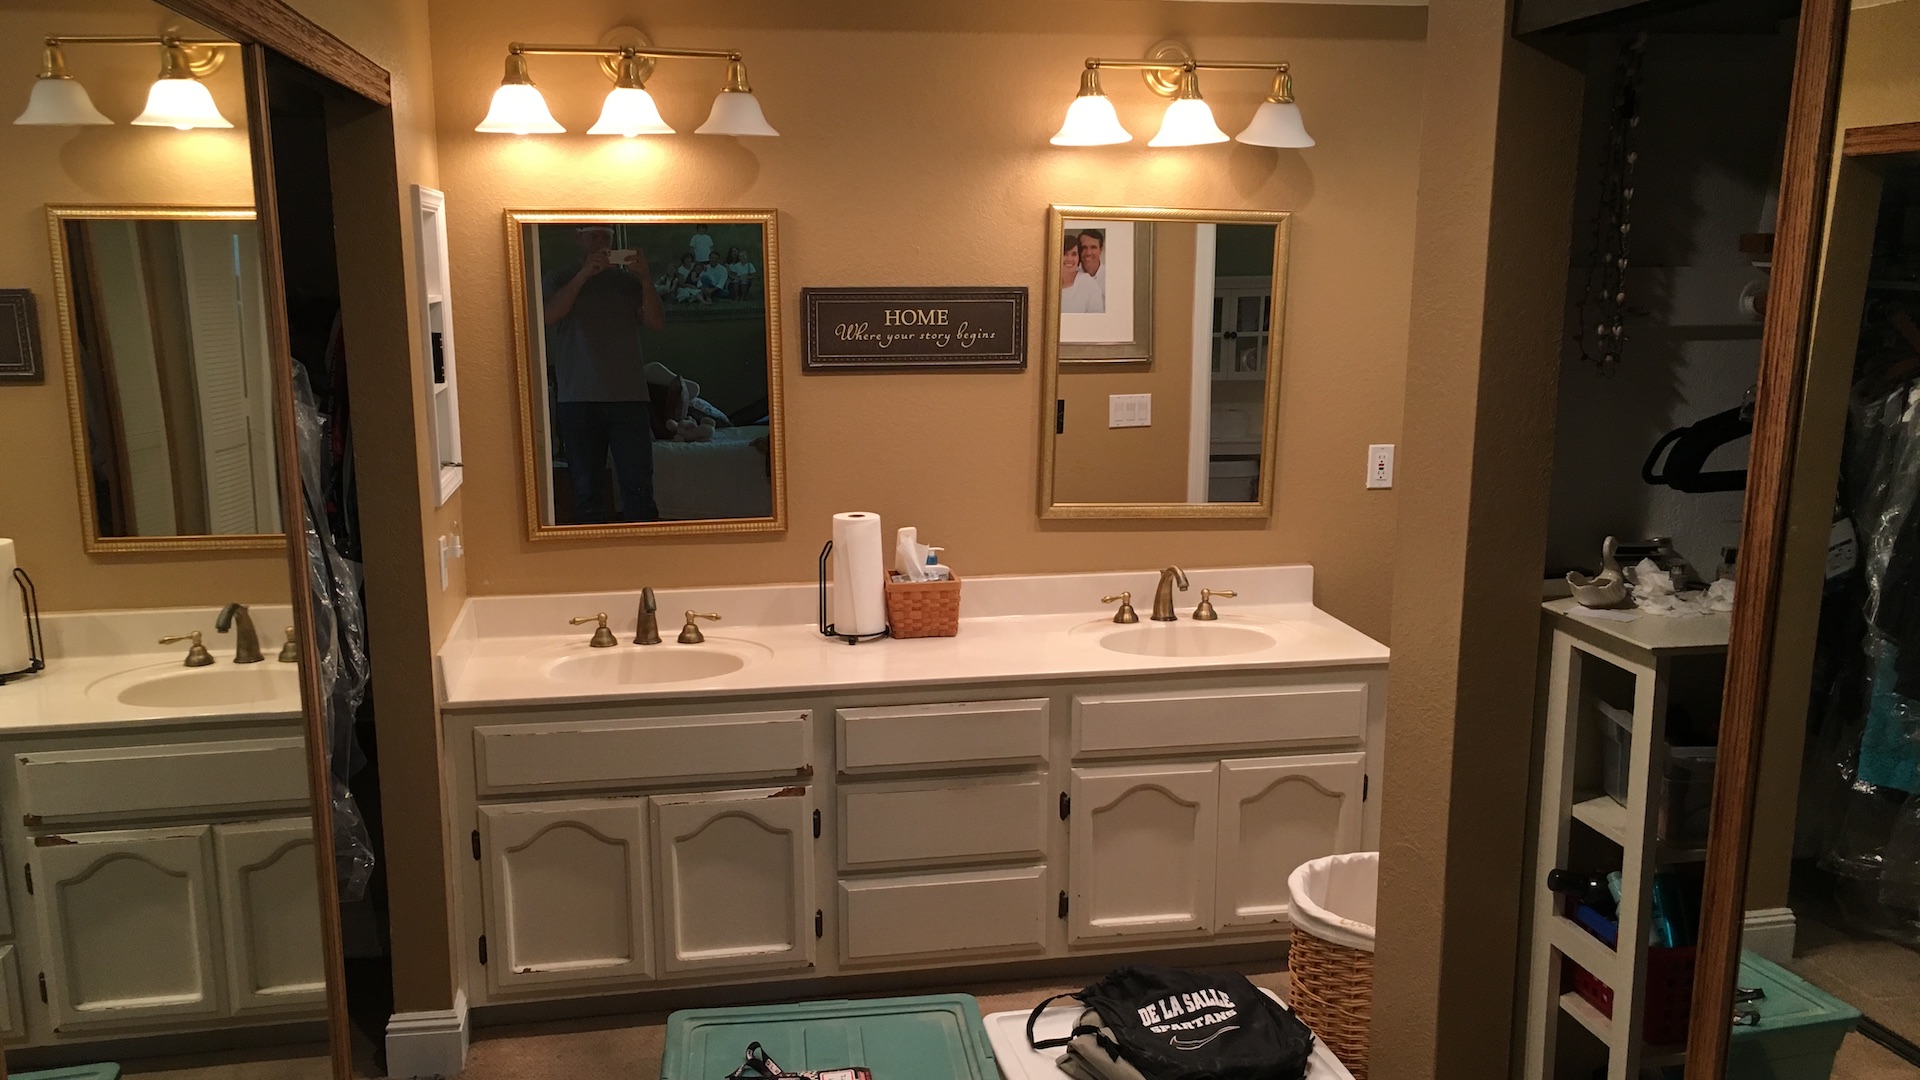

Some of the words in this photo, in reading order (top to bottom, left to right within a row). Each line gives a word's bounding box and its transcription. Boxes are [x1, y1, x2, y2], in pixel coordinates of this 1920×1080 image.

[884, 309, 949, 326] HOME
[834, 322, 882, 341] Where
[878, 331, 915, 348] your
[919, 331, 951, 348] story
[956, 321, 996, 348] begins
[1137, 1003, 1161, 1027] DE
[1158, 995, 1185, 1020] LA
[1182, 988, 1236, 1013] SALLE
[1149, 1009, 1237, 1033] SPARTANS
